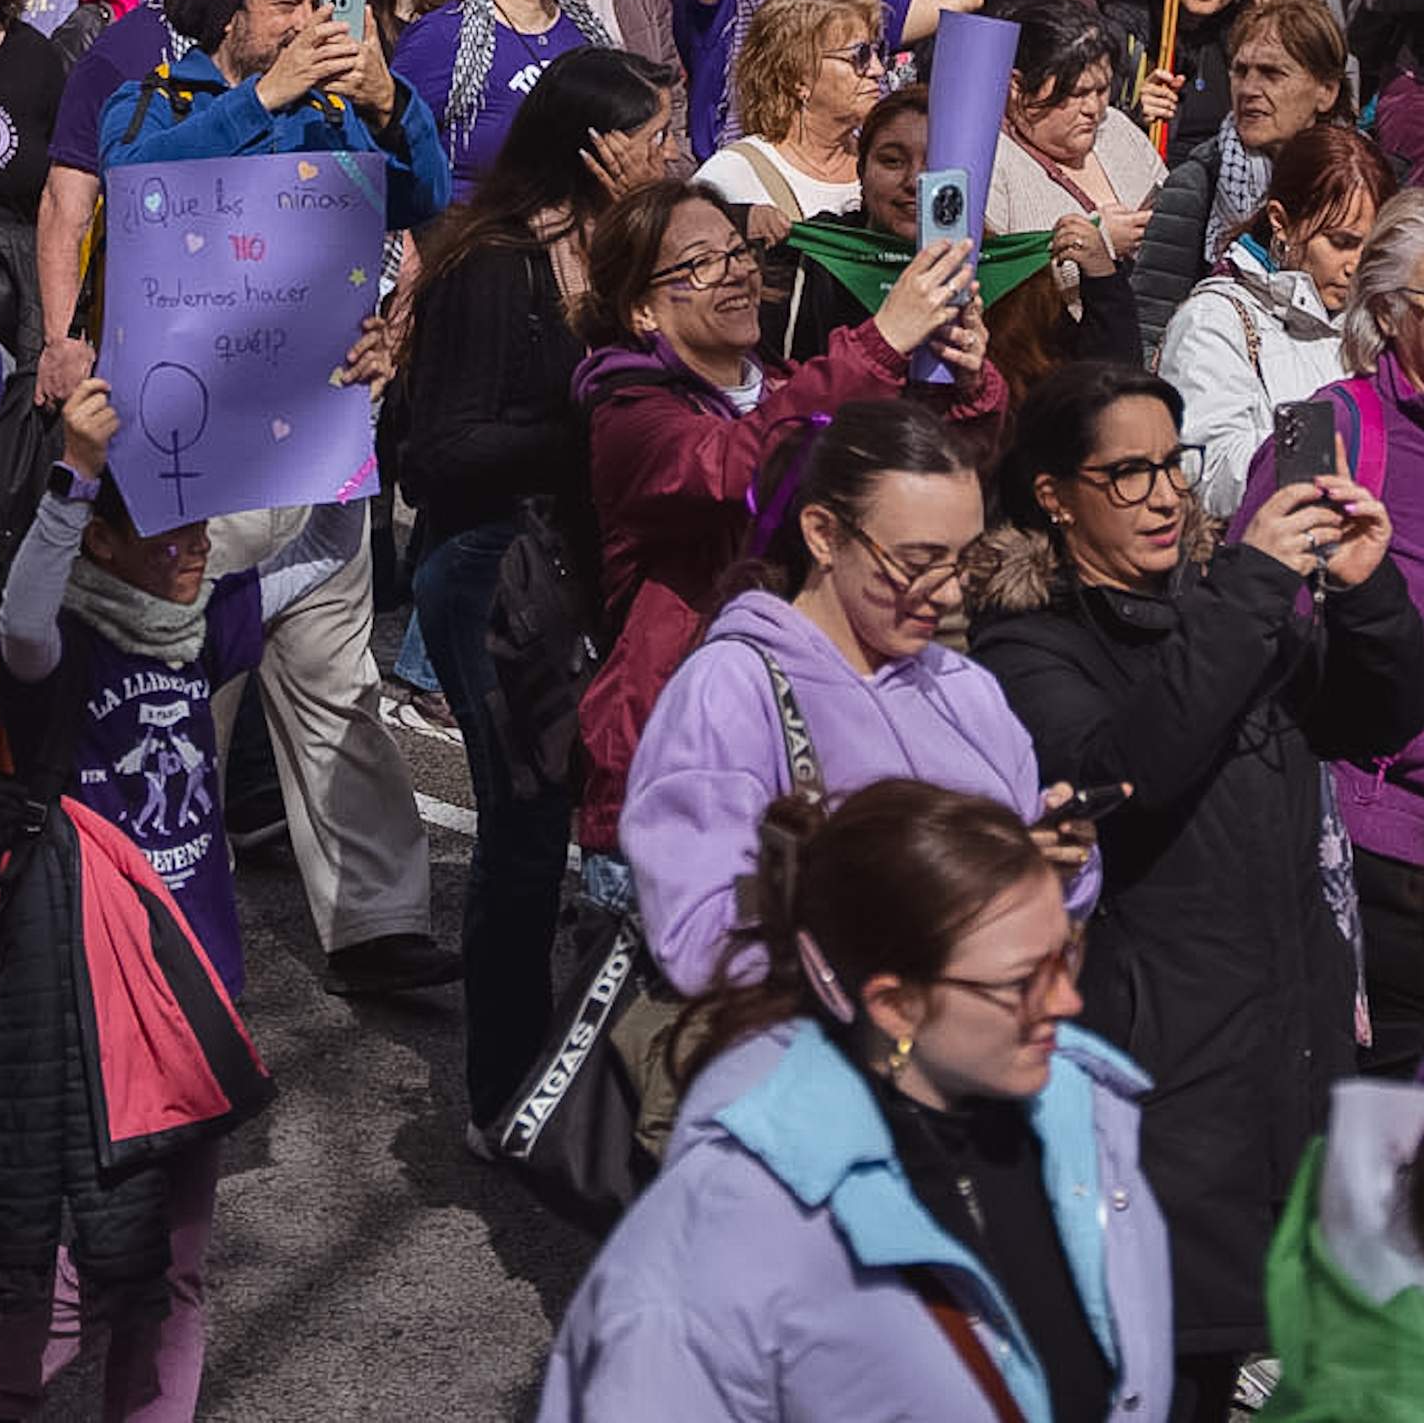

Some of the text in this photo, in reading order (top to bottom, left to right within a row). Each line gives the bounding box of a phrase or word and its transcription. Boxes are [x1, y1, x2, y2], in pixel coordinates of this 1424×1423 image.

[508, 59, 553, 95] TO
[276, 185, 351, 212] niñas
[142, 276, 311, 309] Podemos hacer
[86, 687, 123, 720] LA
[513, 1021, 595, 1141] JAGAS
